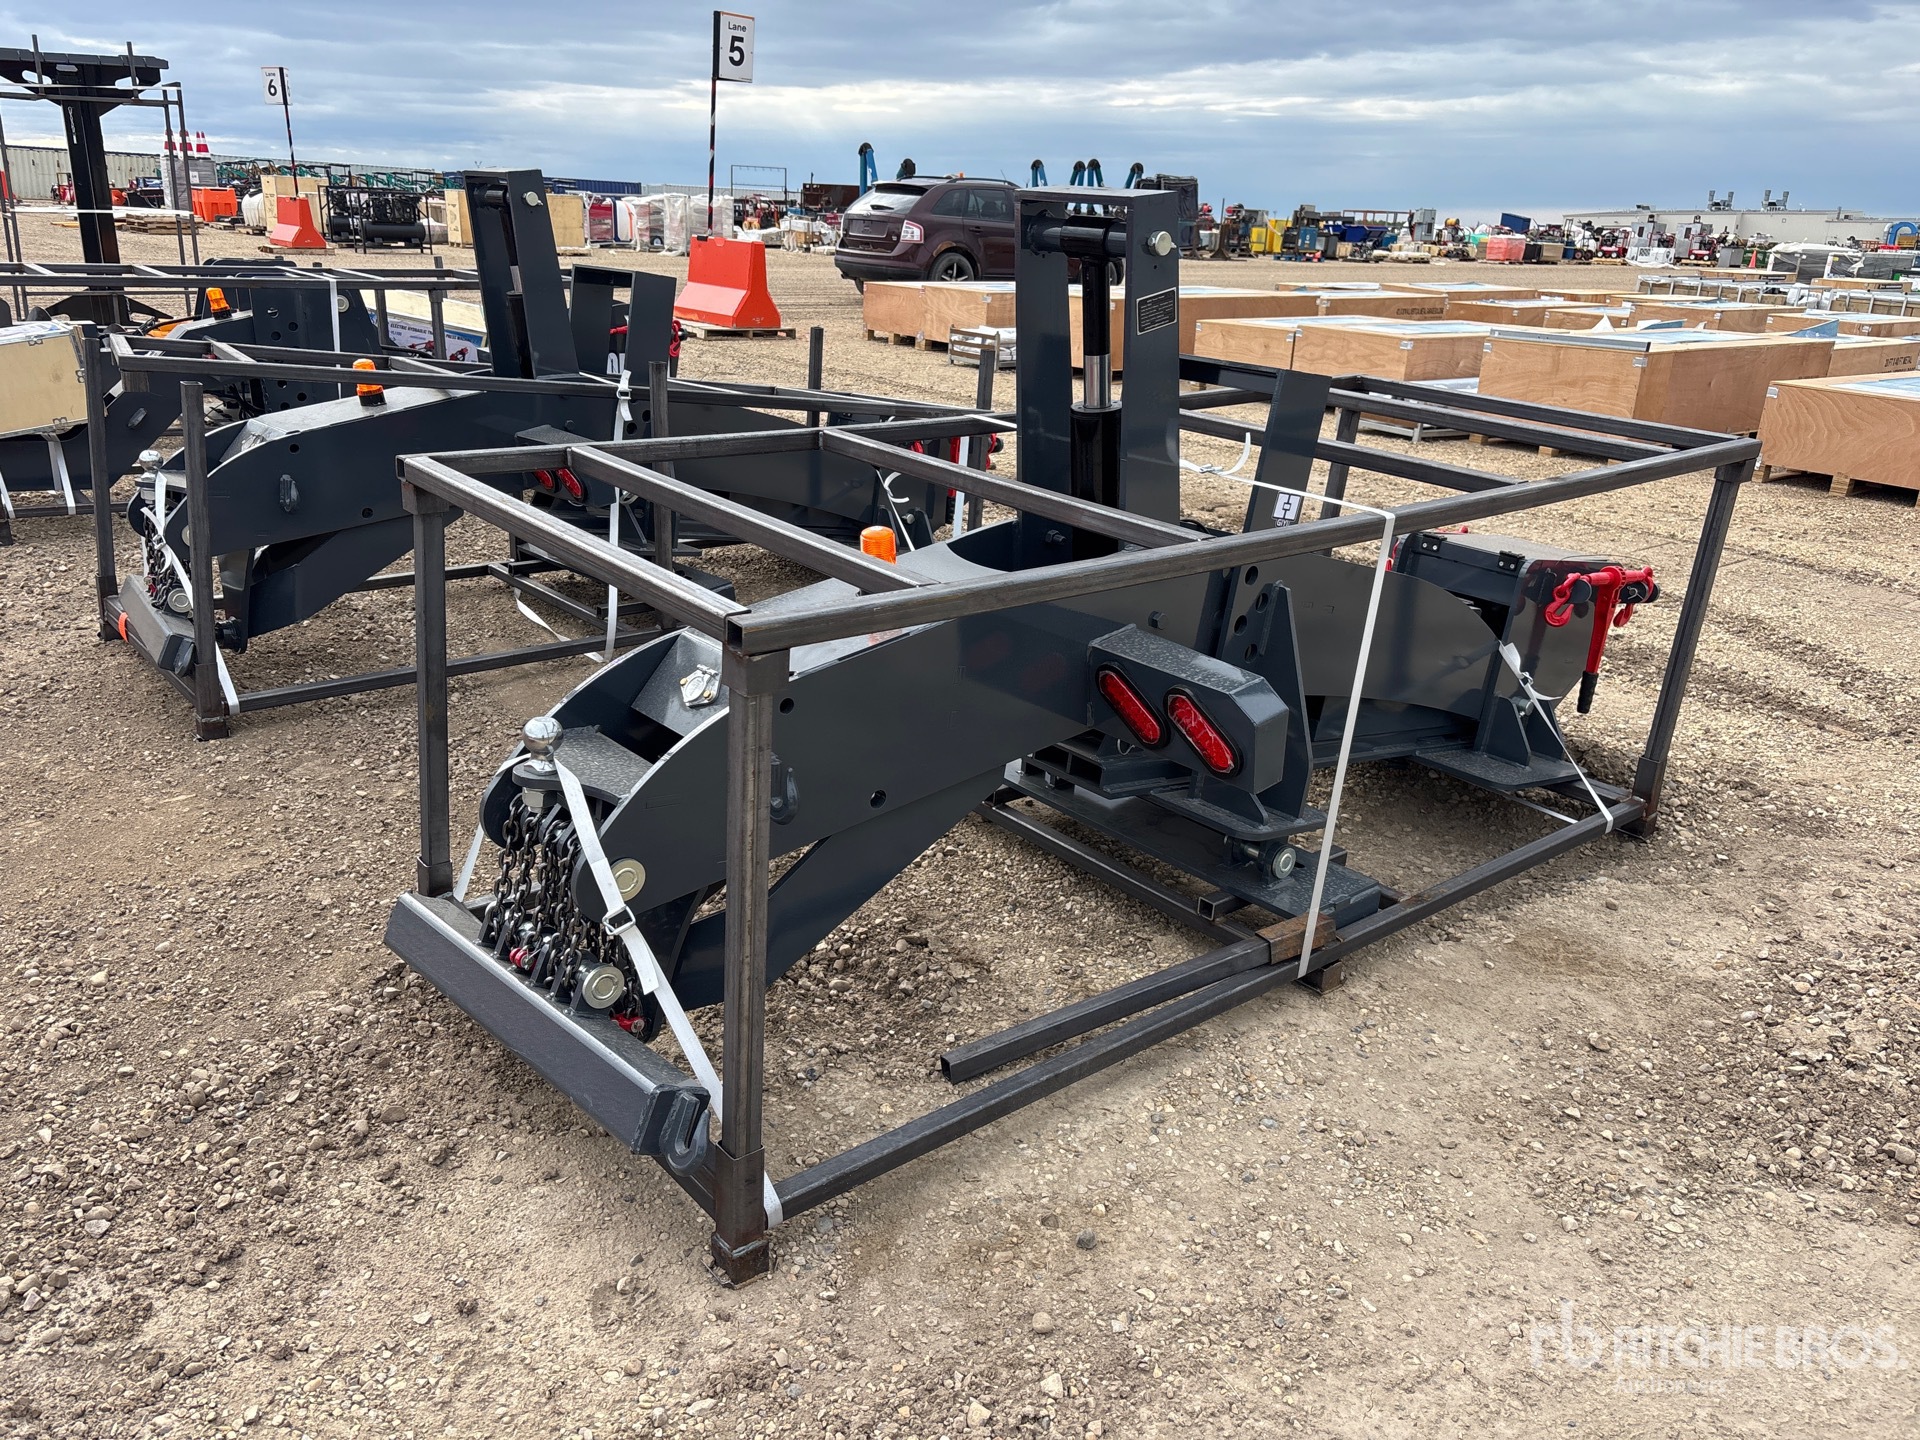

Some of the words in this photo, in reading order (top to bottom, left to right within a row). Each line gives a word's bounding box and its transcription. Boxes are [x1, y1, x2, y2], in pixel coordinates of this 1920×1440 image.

[728, 21, 747, 33] Lane
[728, 35, 745, 67] 5
[268, 79, 278, 97] 6
